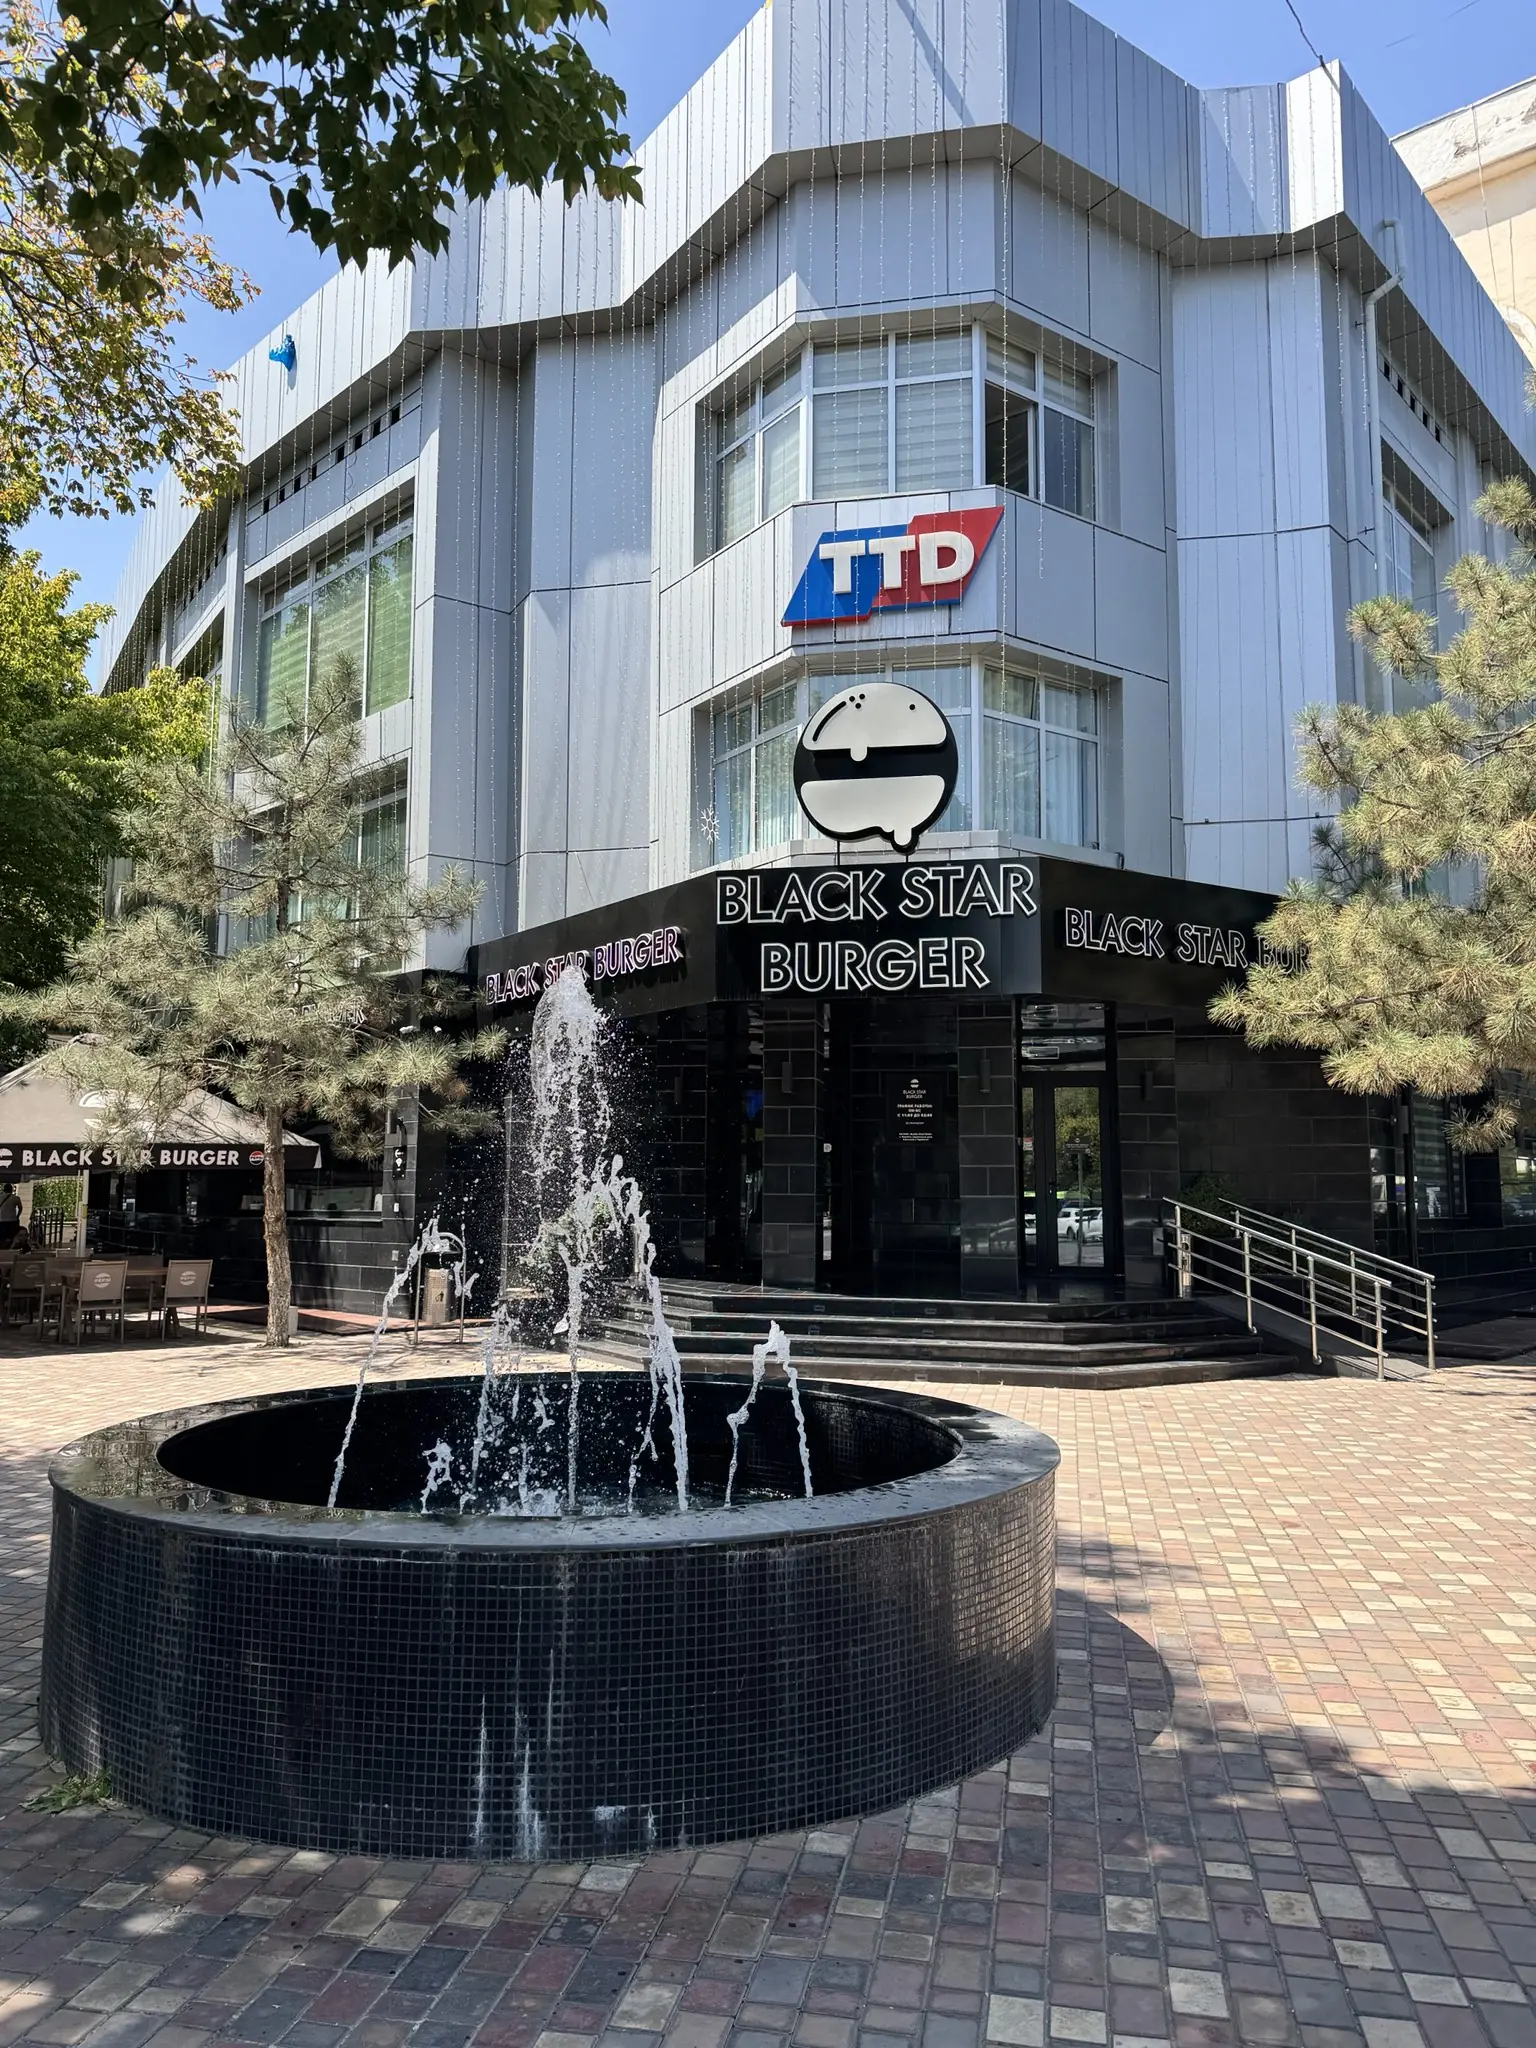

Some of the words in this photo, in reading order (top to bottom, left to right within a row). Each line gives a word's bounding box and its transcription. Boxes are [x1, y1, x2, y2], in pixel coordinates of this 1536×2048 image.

[819, 531, 975, 594] TTD
[717, 869, 888, 924] BLACK
[899, 864, 1037, 918] STAR
[486, 962, 540, 1005] BLACK
[594, 926, 683, 981] BURGER
[761, 937, 990, 992] BURGER
[1066, 907, 1165, 958] BLACK
[1177, 923, 1248, 968] STAR
[1258, 936, 1309, 974] BUR
[22, 1150, 93, 1166] BLACK
[101, 1149, 153, 1167] STR
[159, 1149, 239, 1166] BURGER
